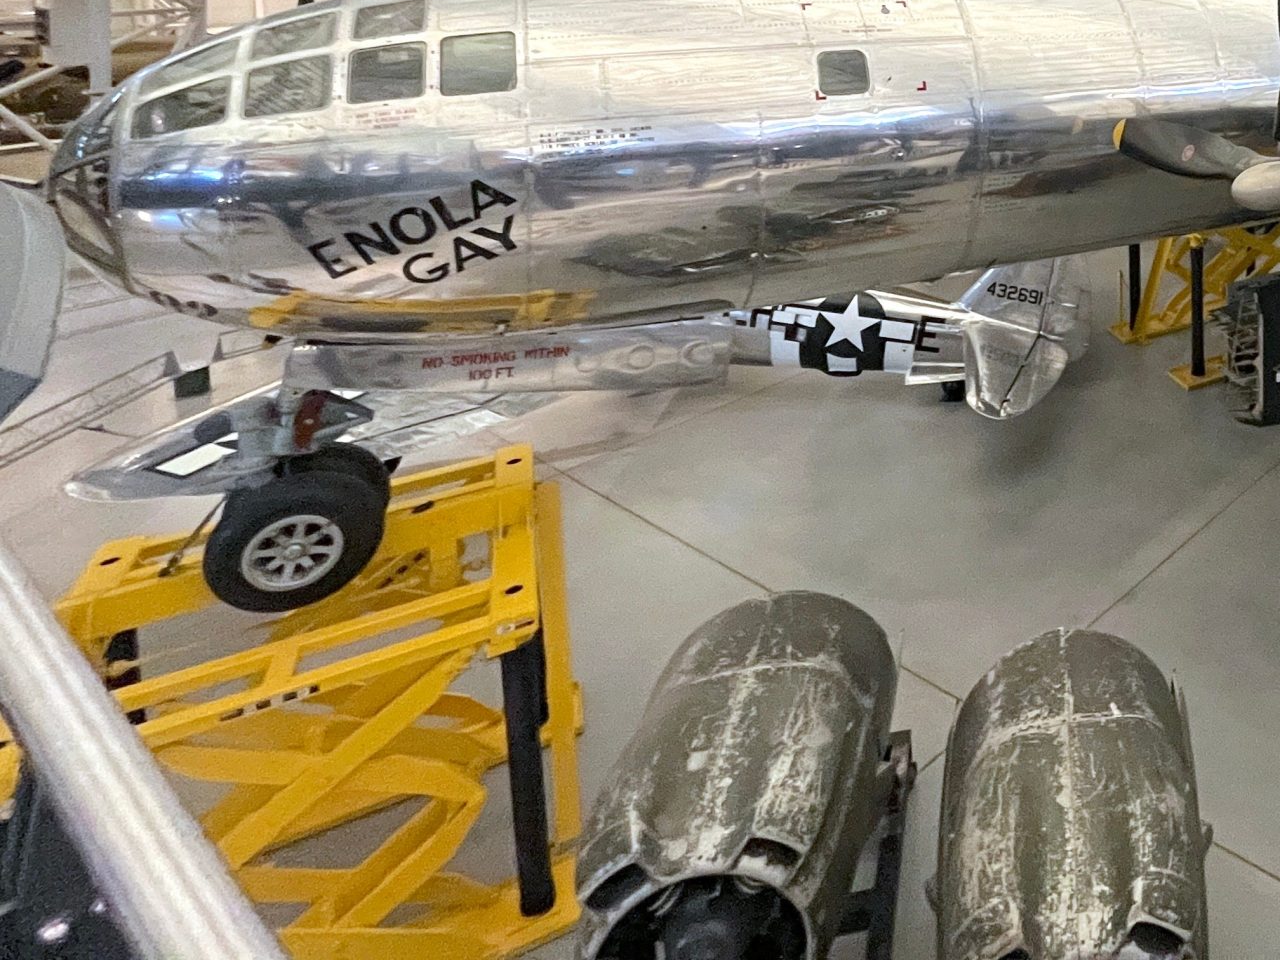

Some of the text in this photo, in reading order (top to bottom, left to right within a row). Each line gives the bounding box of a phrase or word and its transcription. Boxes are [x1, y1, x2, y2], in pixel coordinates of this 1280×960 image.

[307, 179, 517, 280] ENOLA
[402, 214, 518, 284] GAY
[986, 281, 1044, 306] 432691
[421, 356, 443, 369] NO
[450, 351, 516, 367] SMOKING
